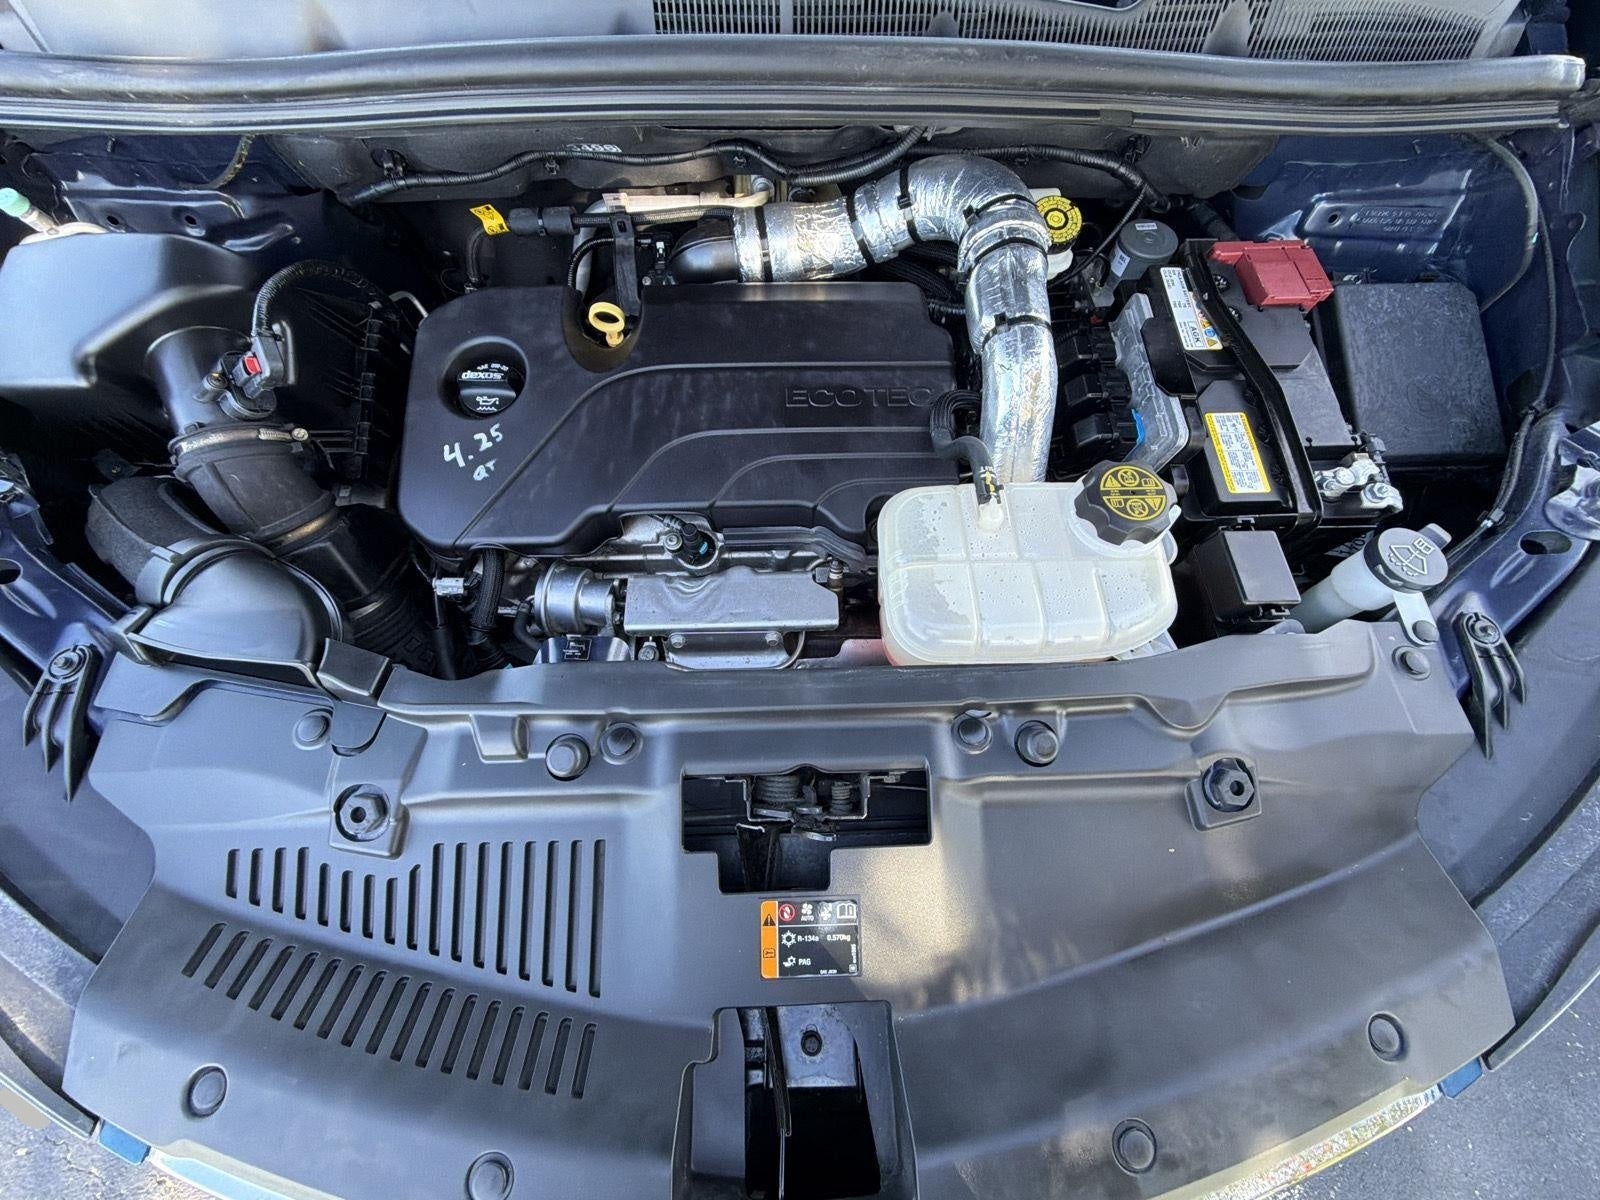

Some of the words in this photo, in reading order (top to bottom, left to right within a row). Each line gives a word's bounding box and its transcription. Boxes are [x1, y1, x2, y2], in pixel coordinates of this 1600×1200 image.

[461, 370, 501, 380] dexos
[785, 387, 935, 407] ECOTEC
[798, 958, 812, 966] PAG
